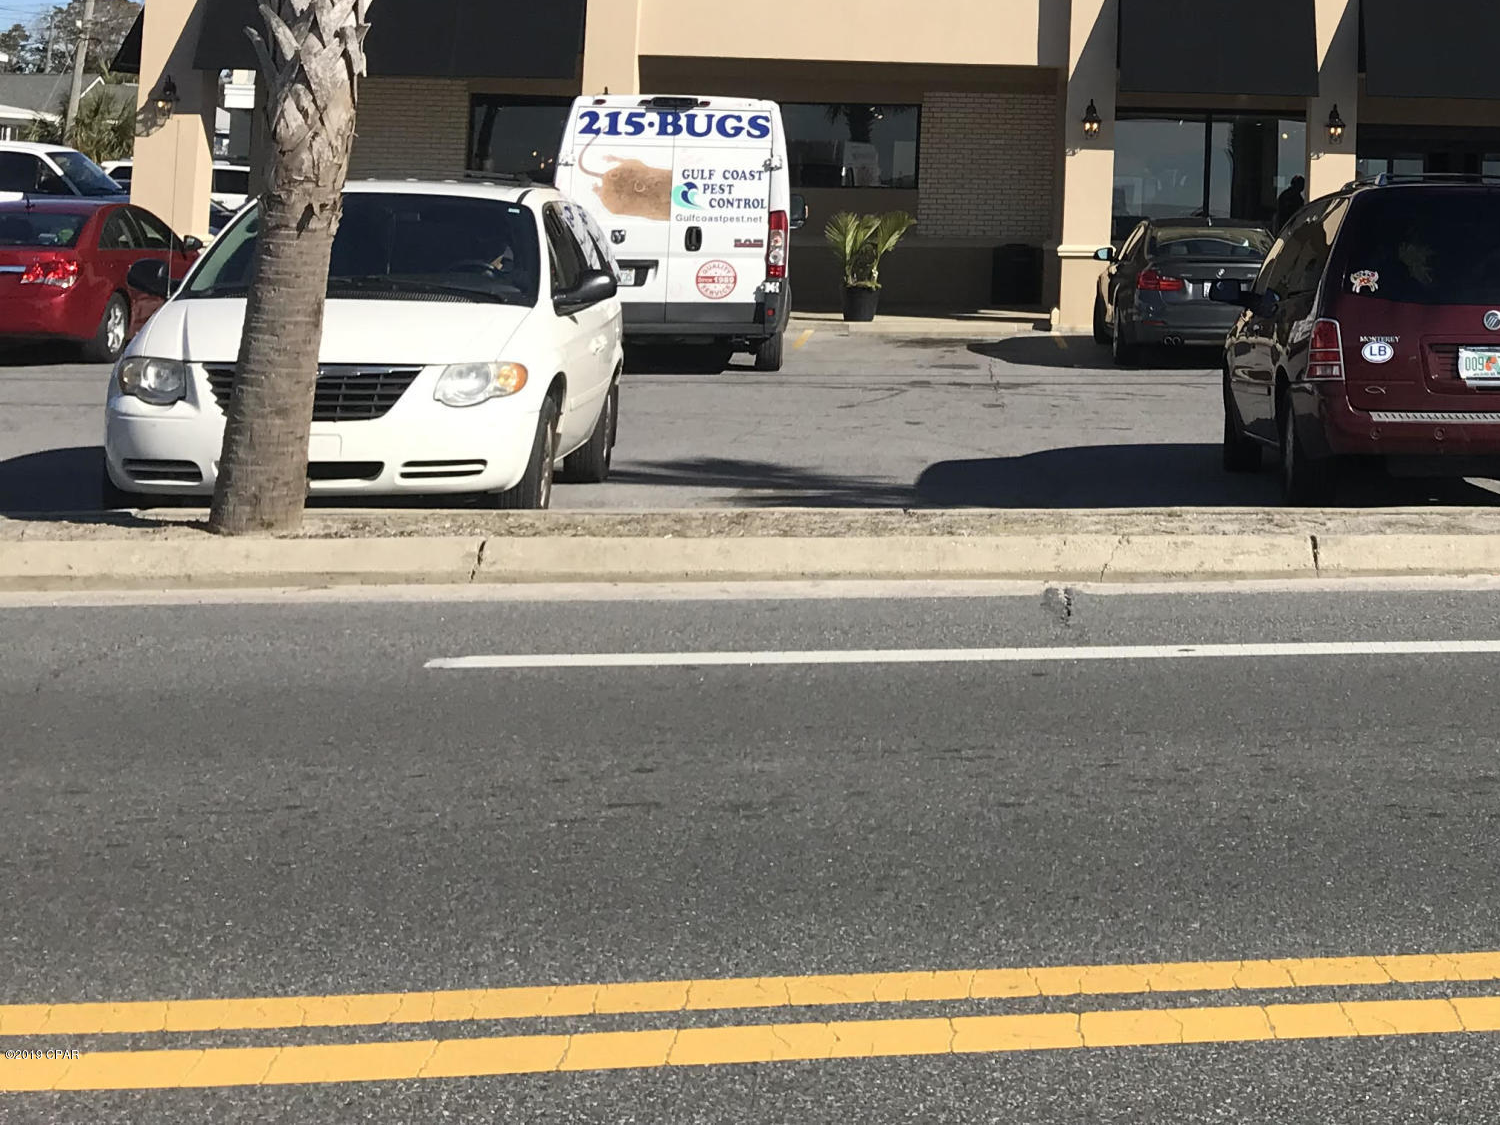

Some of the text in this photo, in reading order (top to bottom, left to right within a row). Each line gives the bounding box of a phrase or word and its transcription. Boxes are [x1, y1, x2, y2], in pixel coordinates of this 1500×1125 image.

[682, 169, 764, 181] GULF COAST
[703, 184, 735, 195] PEST
[709, 198, 767, 209] CONTROL
[675, 214, 763, 224] Gulfcoastpest.net
[702, 264, 731, 275] QUALITY
[1370, 346, 1387, 356] LB
